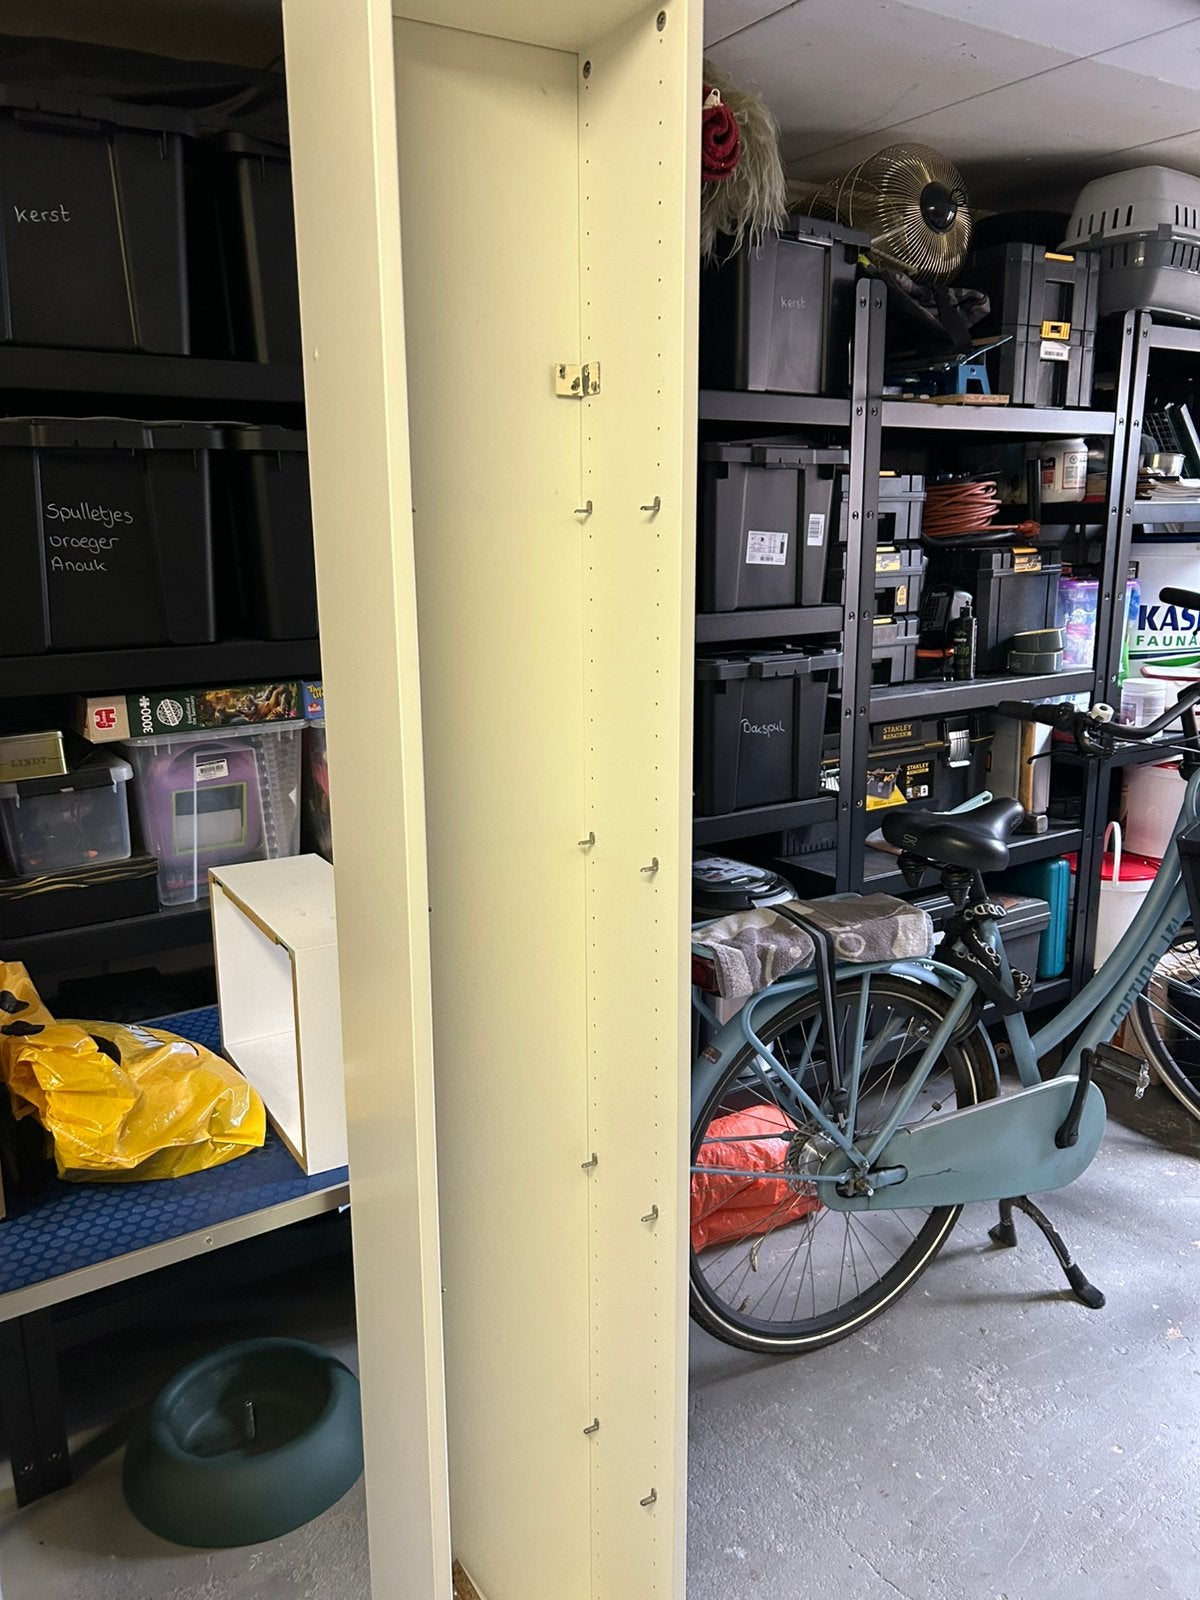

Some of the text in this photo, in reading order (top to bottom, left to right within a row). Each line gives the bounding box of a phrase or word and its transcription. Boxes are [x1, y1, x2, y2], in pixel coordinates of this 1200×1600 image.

[14, 204, 70, 222] kerst
[46, 502, 133, 528] Spulletjes
[49, 535, 119, 554] vroeger
[51, 556, 107, 571] Anouk
[141, 708, 154, 734] 3000
[883, 723, 912, 734] STANLEY
